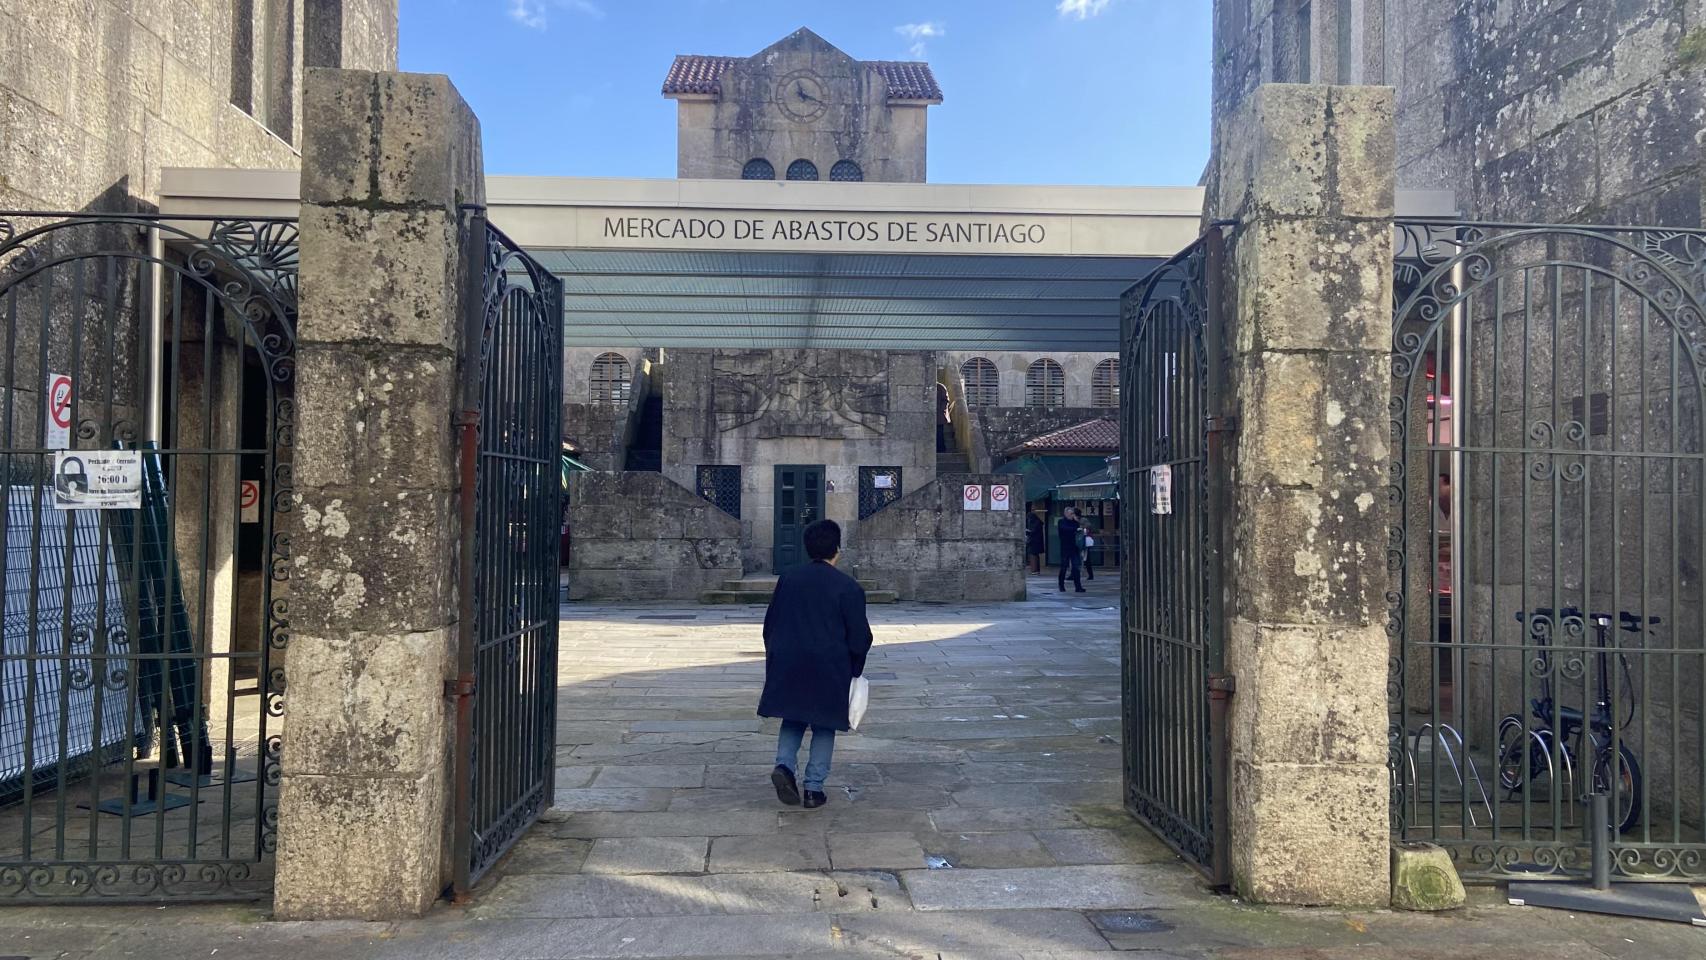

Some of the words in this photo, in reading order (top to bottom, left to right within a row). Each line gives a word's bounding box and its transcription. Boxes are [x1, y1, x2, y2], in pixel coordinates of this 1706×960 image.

[604, 217, 725, 240] MERCADO
[734, 219, 765, 240] DE
[771, 220, 879, 242] ABASTOS
[888, 221, 918, 242] DE
[926, 222, 1046, 244] SANTIAGO
[98, 475, 120, 484] 16:00
